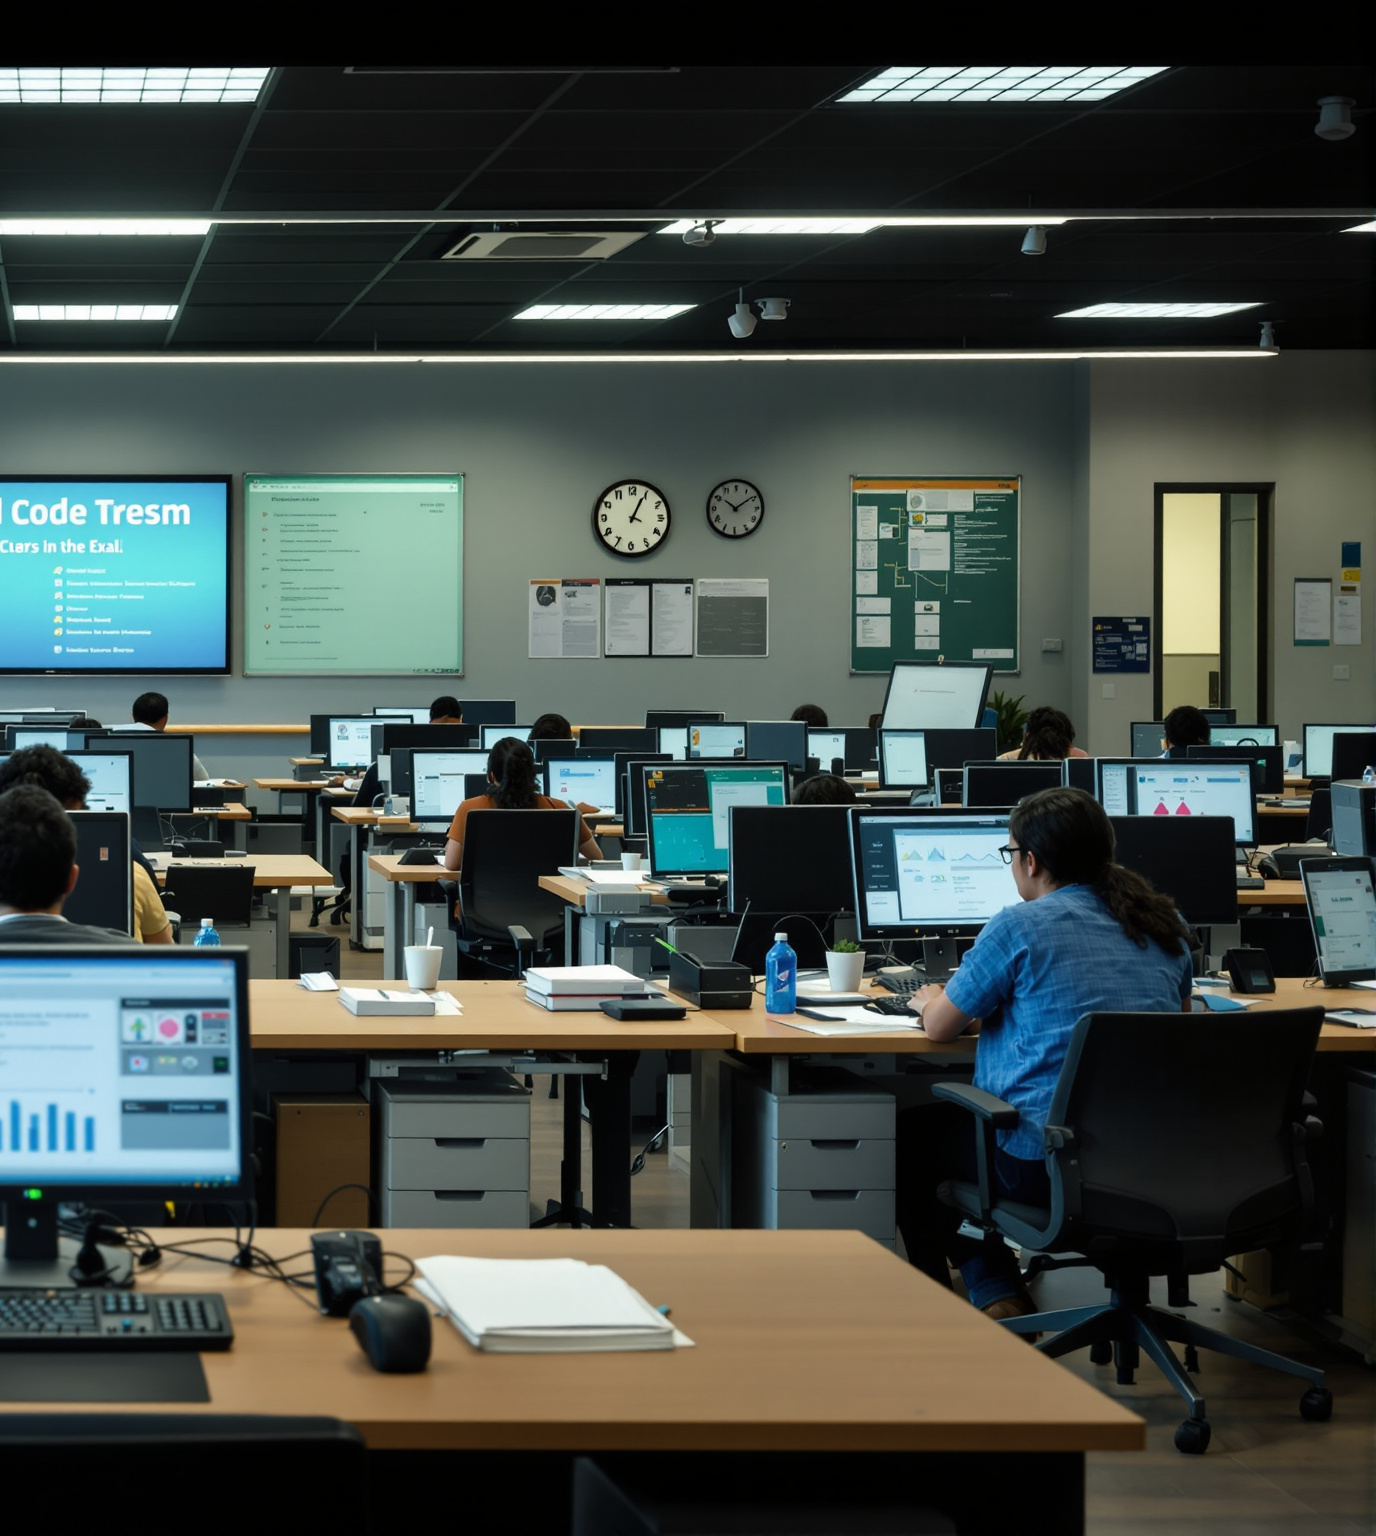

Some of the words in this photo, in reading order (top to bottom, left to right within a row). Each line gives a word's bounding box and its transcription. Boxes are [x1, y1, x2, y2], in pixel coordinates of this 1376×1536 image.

[11, 497, 88, 526] Code
[94, 498, 191, 526] Tresm
[60, 538, 86, 554] the
